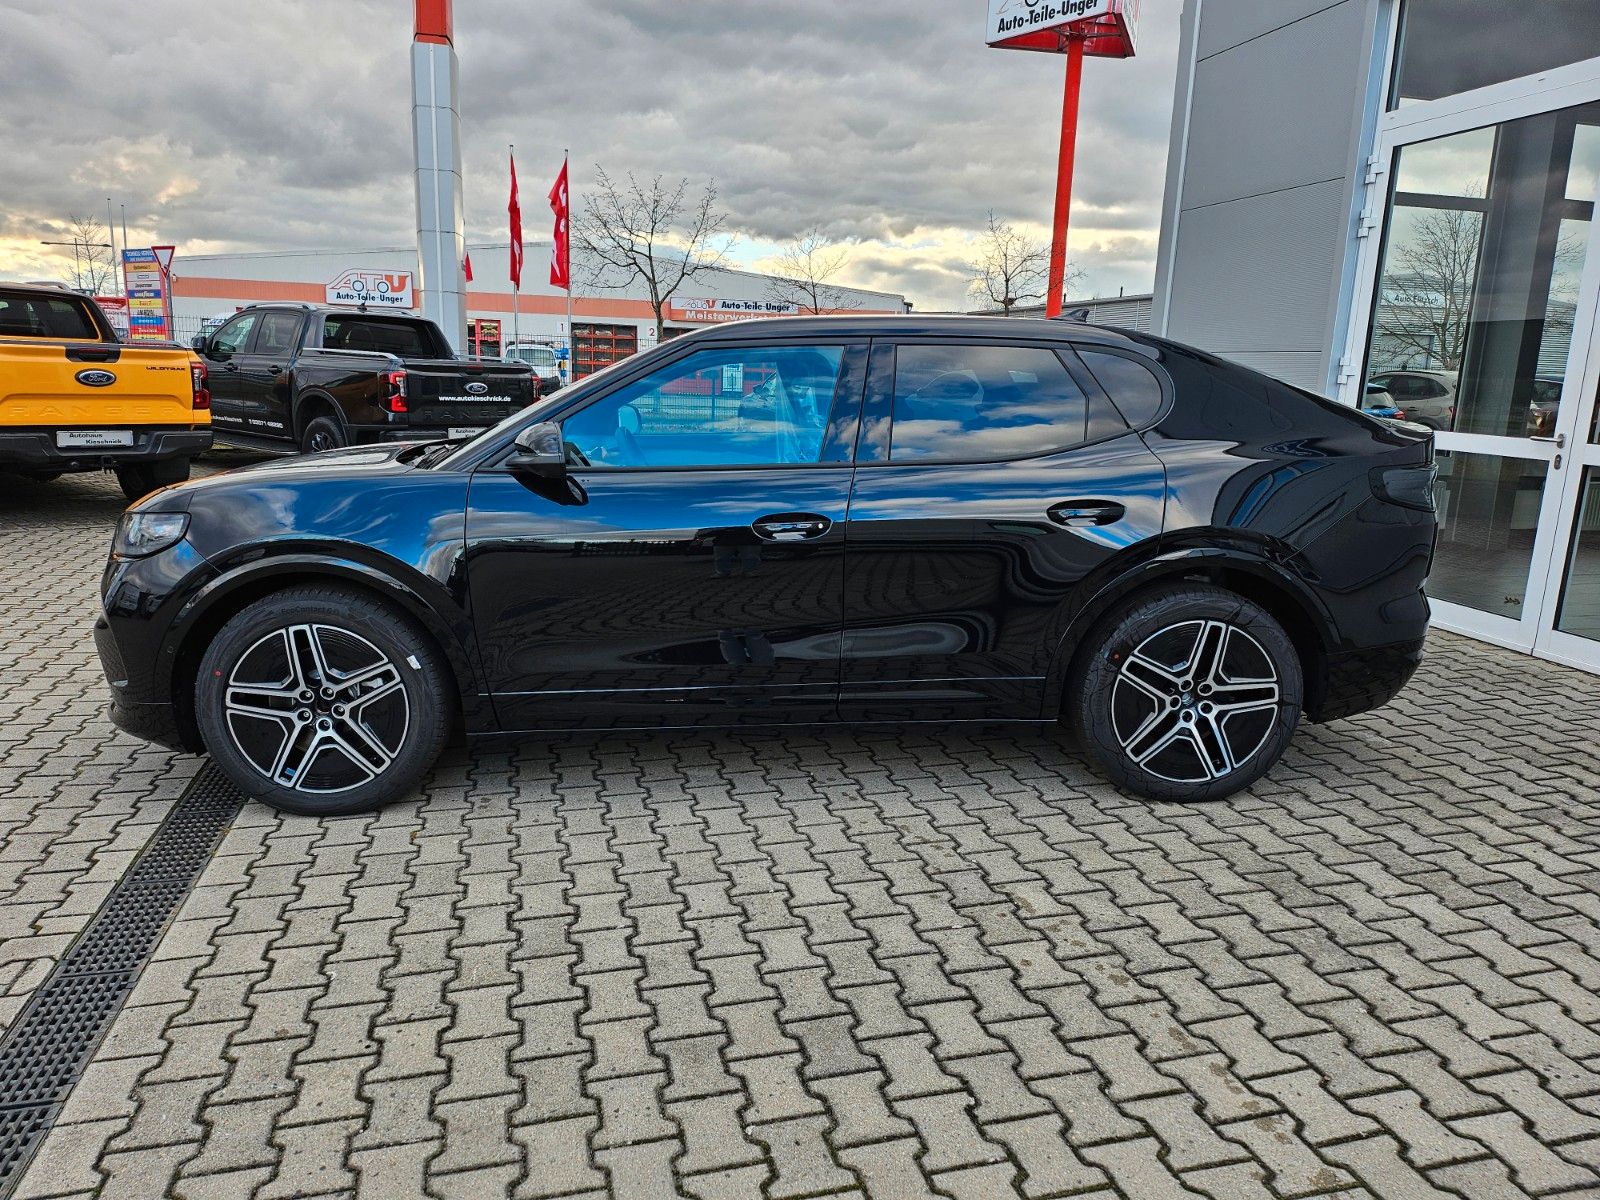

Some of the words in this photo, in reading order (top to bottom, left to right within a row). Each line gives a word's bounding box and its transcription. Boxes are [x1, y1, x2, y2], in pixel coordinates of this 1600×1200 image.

[998, 0, 1098, 33] Auto-Teile-Unger
[336, 292, 404, 304] Auto-Teile-Unger
[721, 301, 790, 312] Auto-Teile-Unger
[560, 323, 564, 332] 1
[649, 328, 655, 336] 2
[9, 405, 178, 417] RANGER
